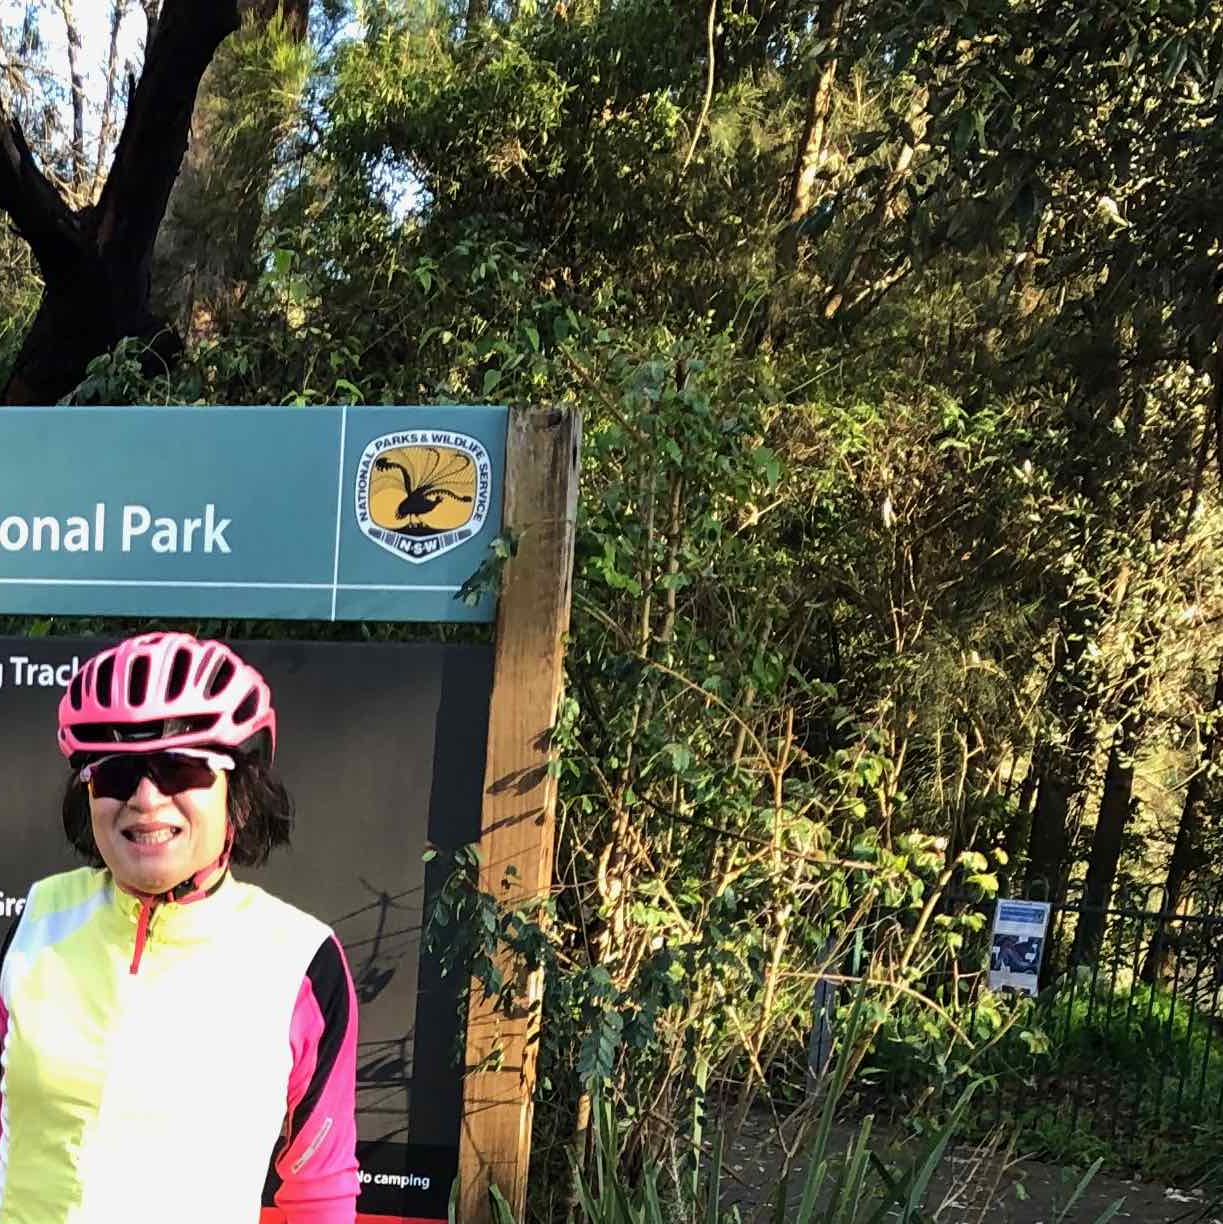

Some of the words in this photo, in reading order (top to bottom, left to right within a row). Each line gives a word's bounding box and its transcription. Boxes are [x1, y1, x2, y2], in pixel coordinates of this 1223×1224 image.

[358, 451, 376, 522] NATIONAL
[375, 433, 418, 451] PARKS
[419, 434, 427, 443] &
[431, 433, 486, 462] WILDLIFE
[473, 462, 489, 522] SERVICE
[122, 504, 232, 553] Park
[374, 1173, 431, 1190] camping
